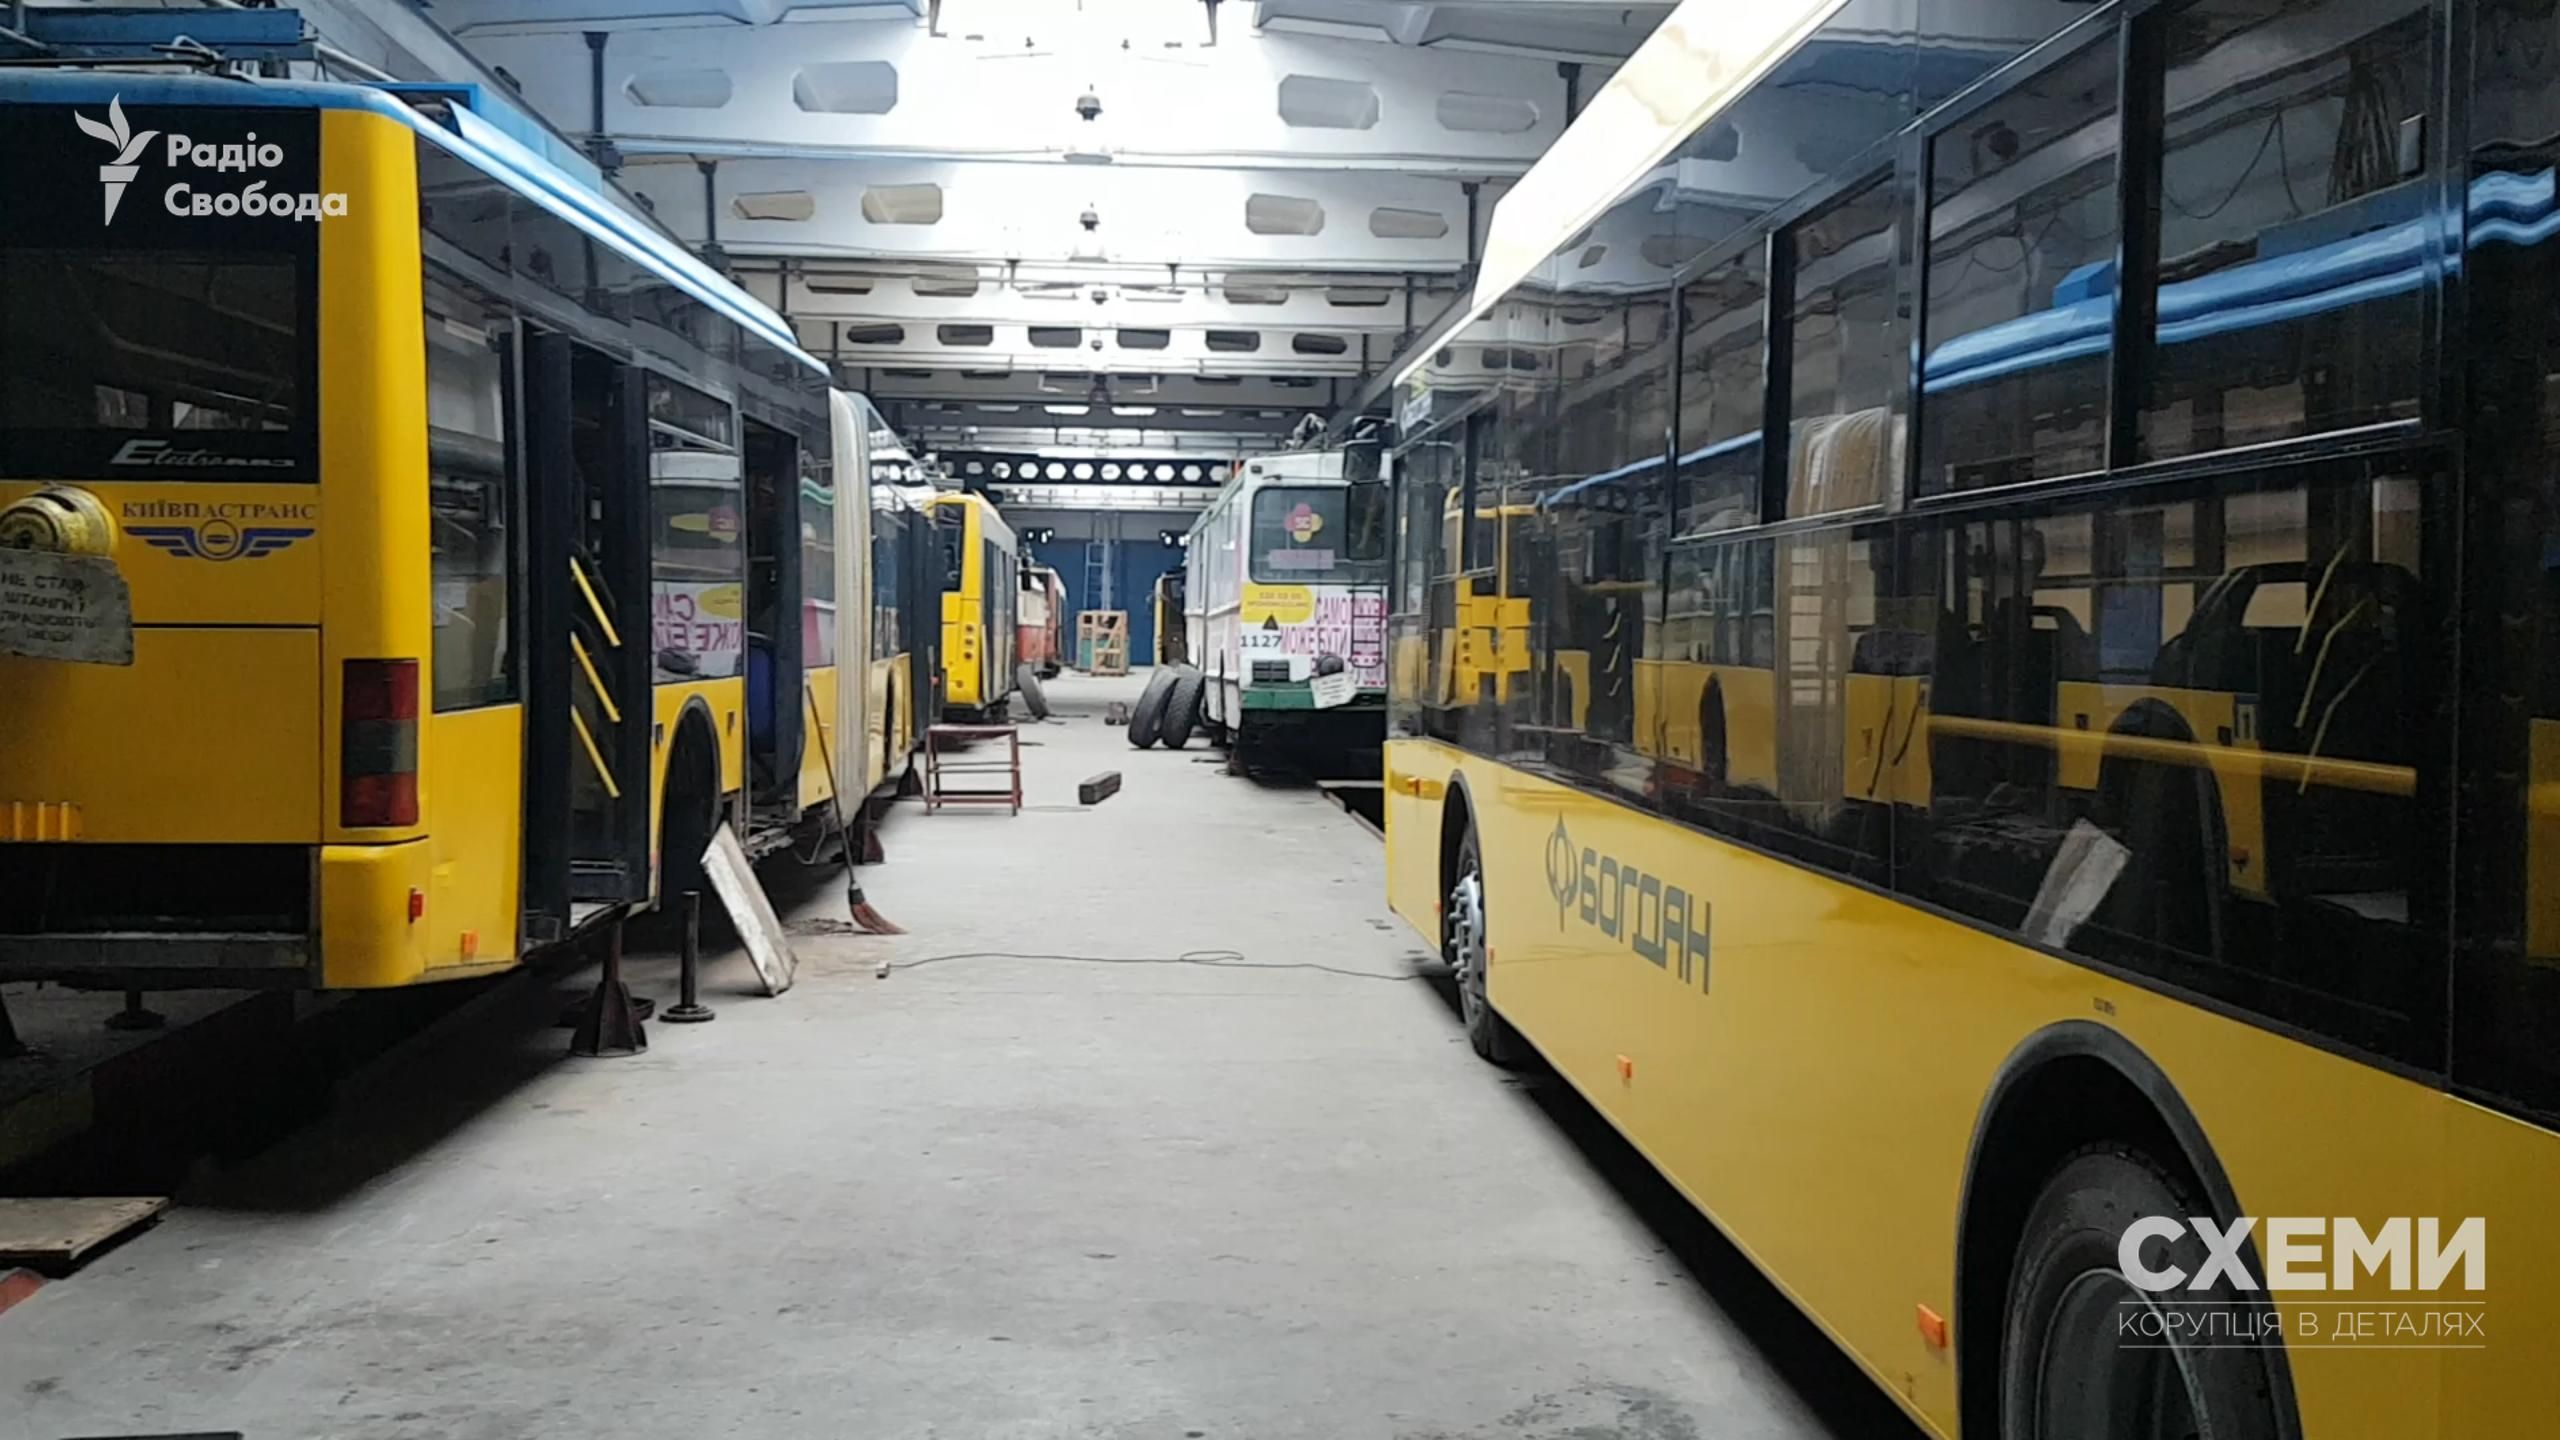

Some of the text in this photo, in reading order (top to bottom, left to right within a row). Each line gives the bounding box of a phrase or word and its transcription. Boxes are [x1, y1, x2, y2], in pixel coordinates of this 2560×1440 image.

[122, 500, 317, 519] КИЇВПАСТРАНС
[1240, 635, 1281, 648] 1127
[1580, 846, 1712, 995] БОГДАН
